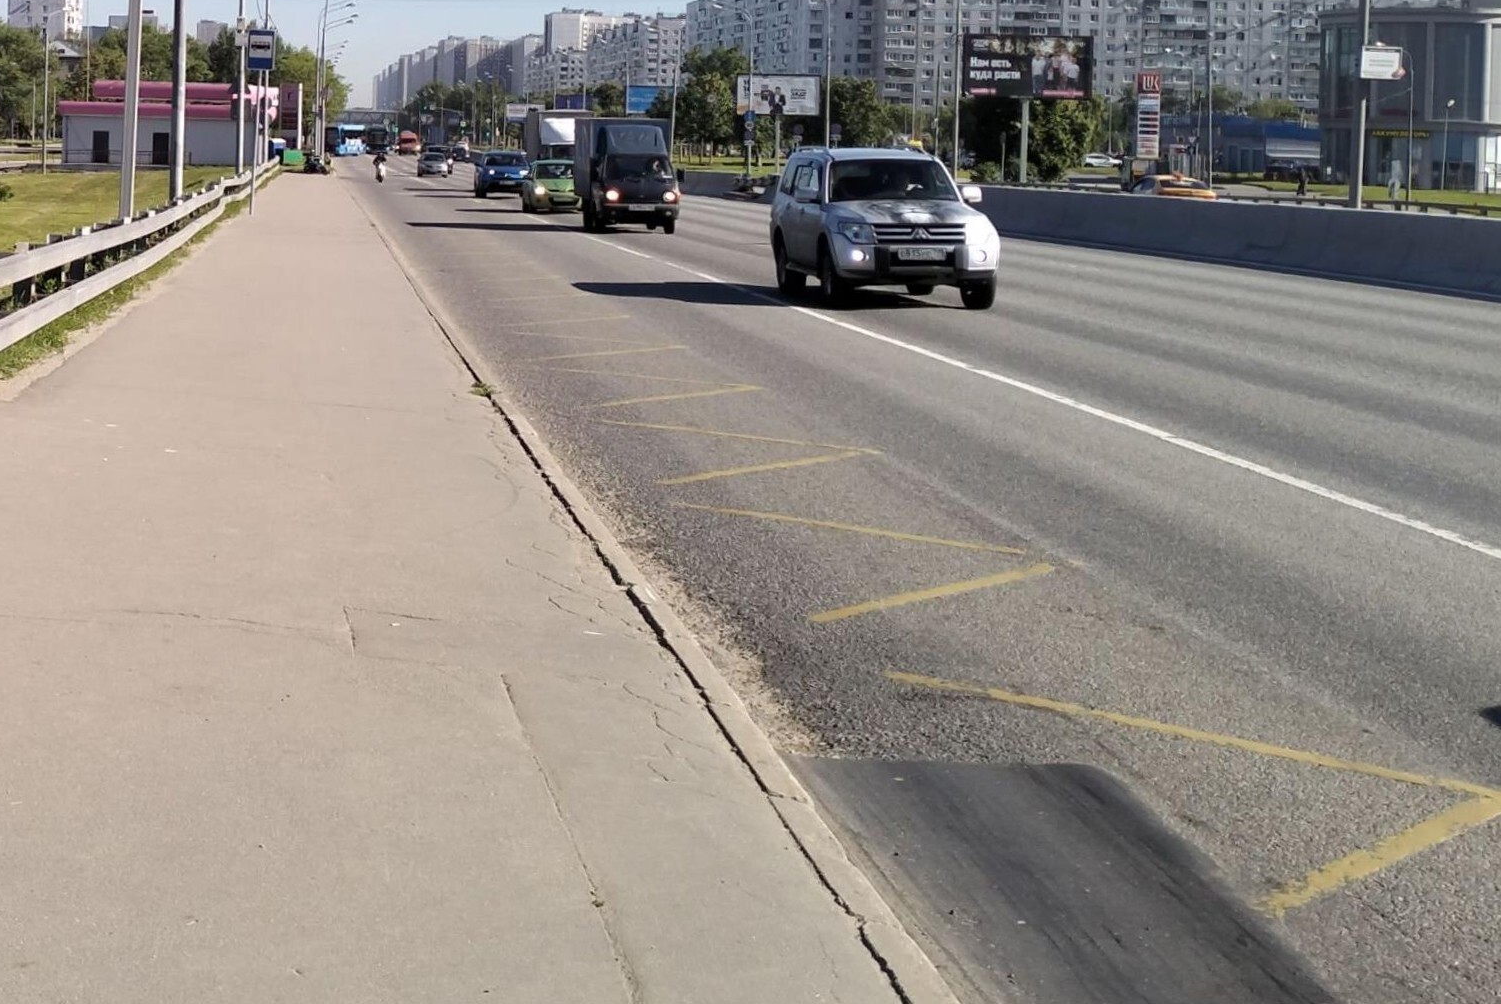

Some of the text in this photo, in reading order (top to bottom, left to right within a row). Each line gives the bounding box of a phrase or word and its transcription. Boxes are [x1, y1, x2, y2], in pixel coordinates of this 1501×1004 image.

[970, 57, 1012, 68] Нам есть
[970, 71, 992, 81] куда
